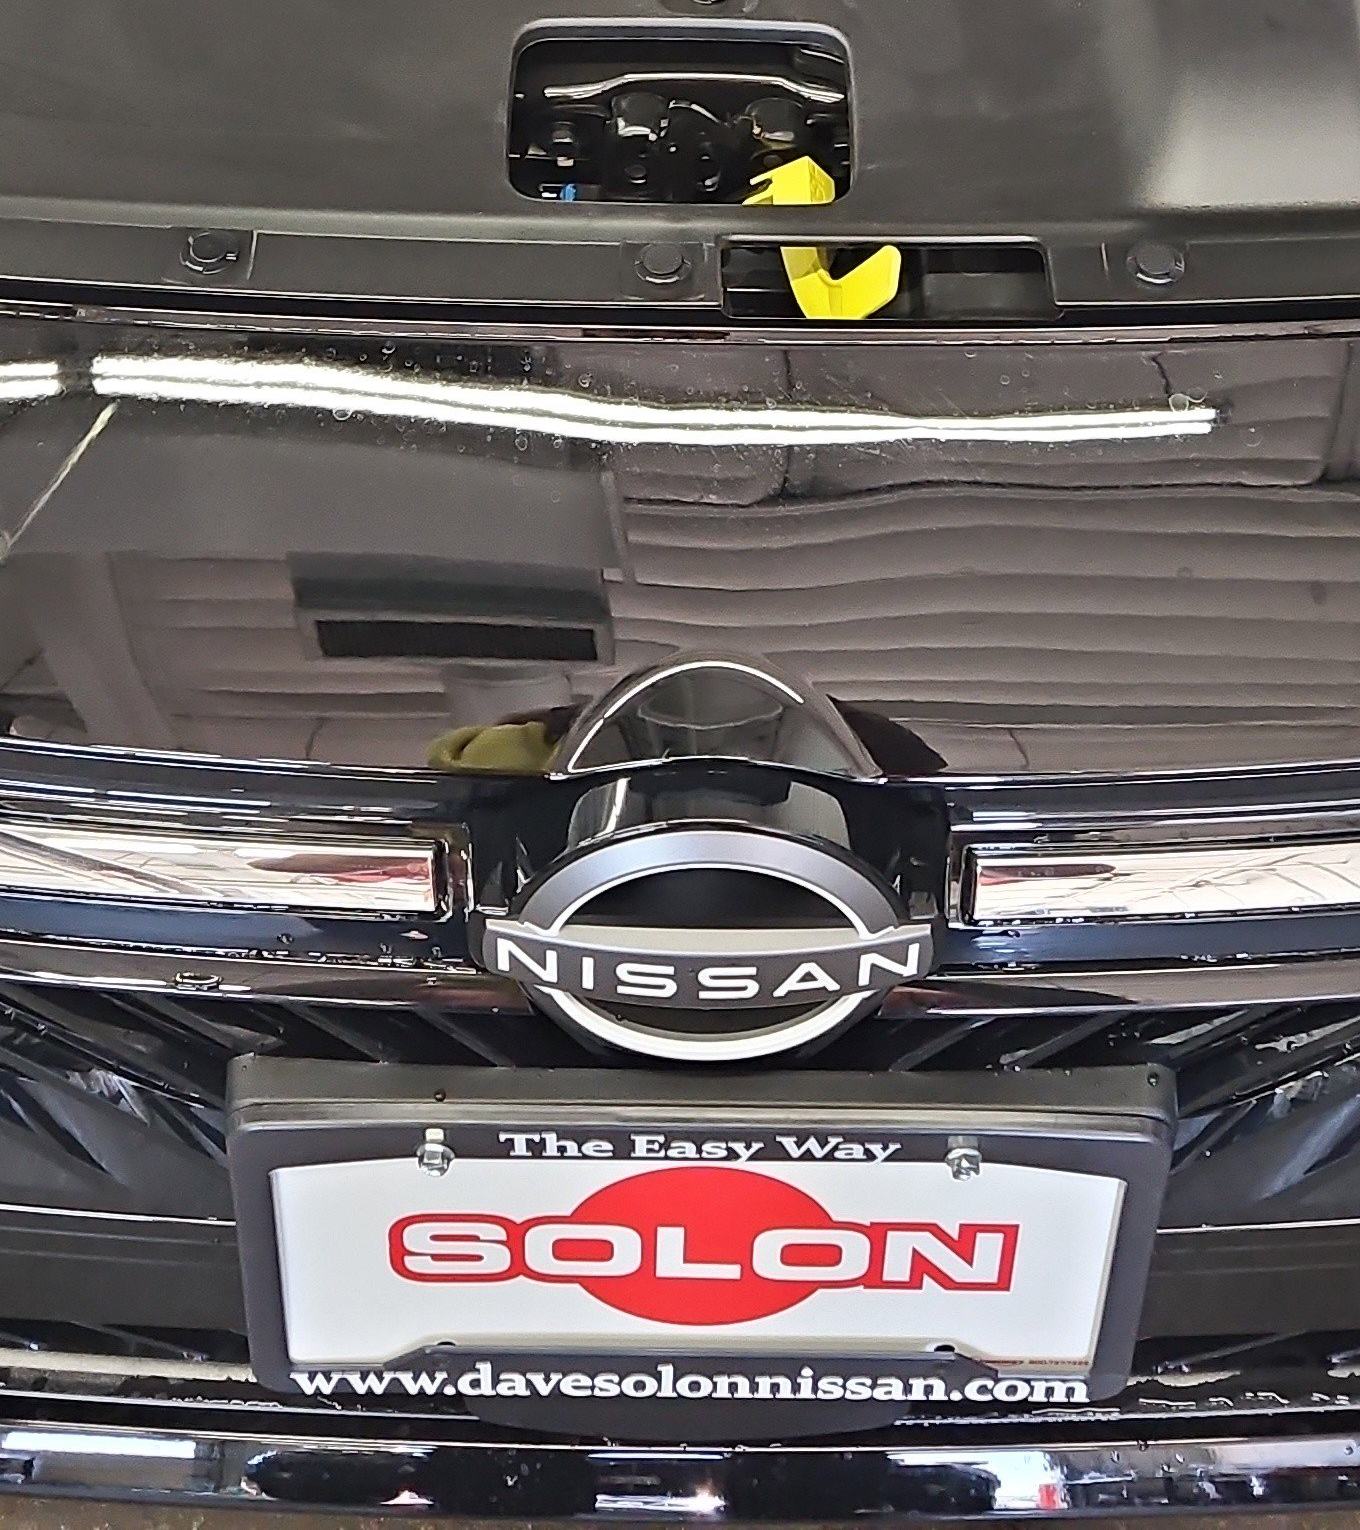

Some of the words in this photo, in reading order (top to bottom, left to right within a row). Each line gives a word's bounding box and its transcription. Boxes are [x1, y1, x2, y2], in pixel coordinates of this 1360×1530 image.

[495, 937, 921, 1000] NISSAN
[499, 1132, 614, 1160] The
[630, 1133, 766, 1165] Easy
[775, 1135, 902, 1165] Way
[391, 1214, 1019, 1291] SOLON
[289, 1363, 1089, 1404] www.davesolonnissan.com
